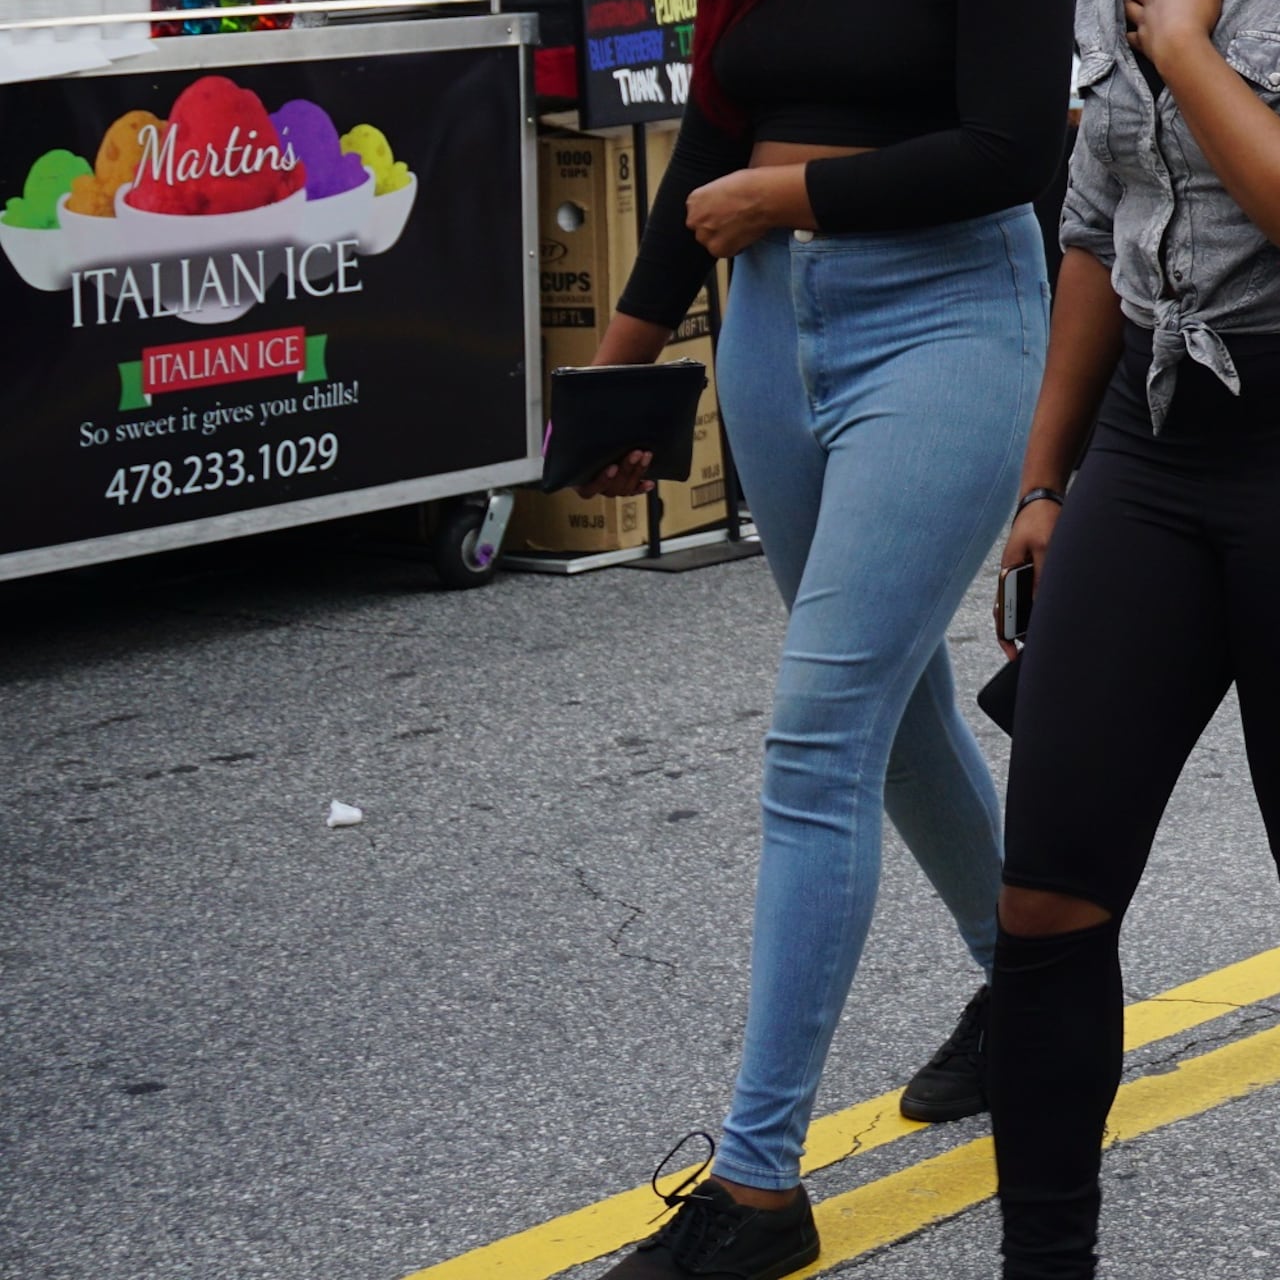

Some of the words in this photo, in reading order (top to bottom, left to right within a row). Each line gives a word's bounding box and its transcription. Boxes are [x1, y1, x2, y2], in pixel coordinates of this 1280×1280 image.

[613, 67, 665, 106] THANK
[133, 123, 300, 191] Martin's
[555, 150, 592, 167] 1000
[619, 154, 629, 180] 8
[71, 250, 267, 329] ITALIAN
[287, 239, 364, 301] ICE
[148, 344, 250, 386] ITALIAN
[258, 334, 300, 370] ICE
[79, 422, 109, 448] So
[115, 413, 176, 442] sweet
[181, 406, 198, 432] it
[202, 401, 255, 436] gives
[260, 396, 299, 428] you
[302, 380, 360, 414] chills!
[105, 431, 339, 507] 478.233.1029
